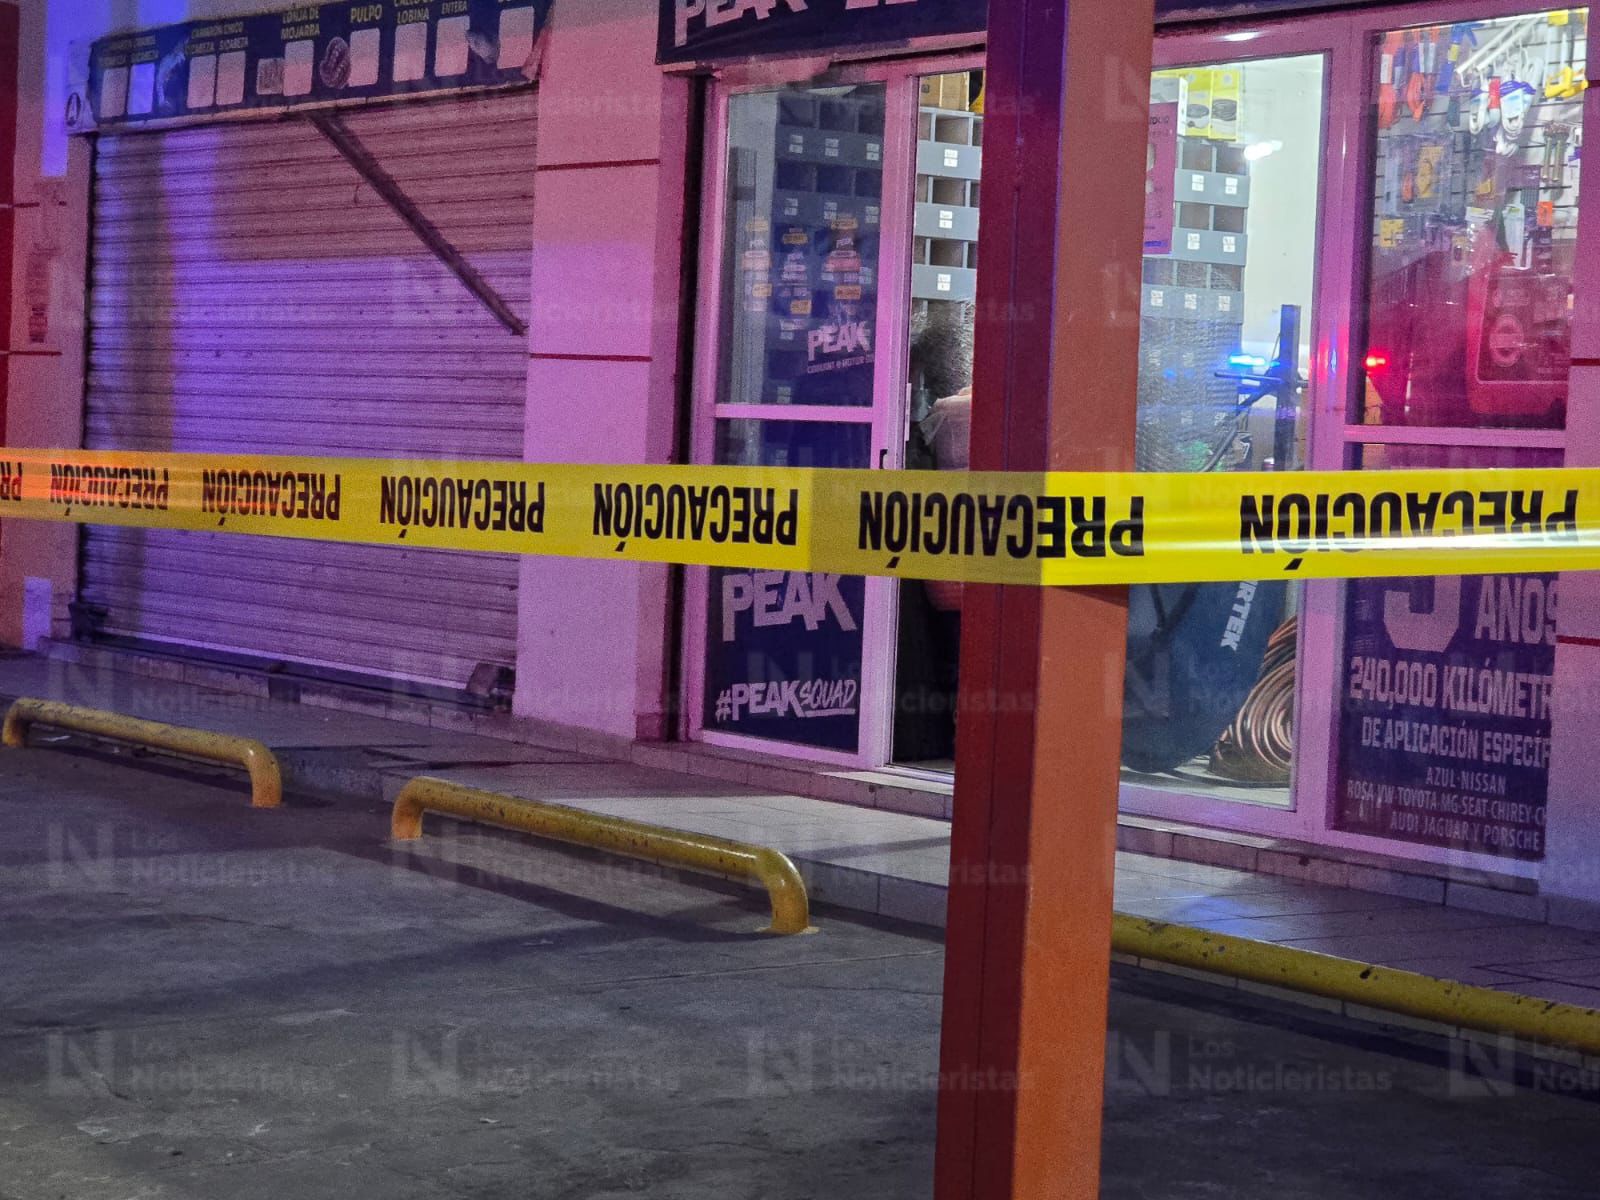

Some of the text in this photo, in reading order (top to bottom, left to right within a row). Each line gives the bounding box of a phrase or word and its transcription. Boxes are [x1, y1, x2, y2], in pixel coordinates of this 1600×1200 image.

[281, 24, 321, 40] MOJARRA
[350, 4, 383, 23] PULPO
[397, 8, 429, 25] LOBINA
[807, 321, 871, 362] PEAK
[50, 463, 169, 516] PRECAUCIÓN
[202, 468, 341, 526] PRECAUCIÓN
[380, 475, 545, 538] PRECAUCIÓN
[593, 482, 797, 552] PRECAUCIÓN
[858, 490, 1145, 568] PRECAUCIÓN
[1239, 488, 1579, 570] PRECAUCIÓN
[722, 571, 858, 642] PEAK
[1350, 656, 1437, 710] 240,000
[1362, 716, 1380, 748] DE
[1384, 717, 1479, 761] APLICACIÓN
[1483, 824, 1540, 851] PORSCHE
